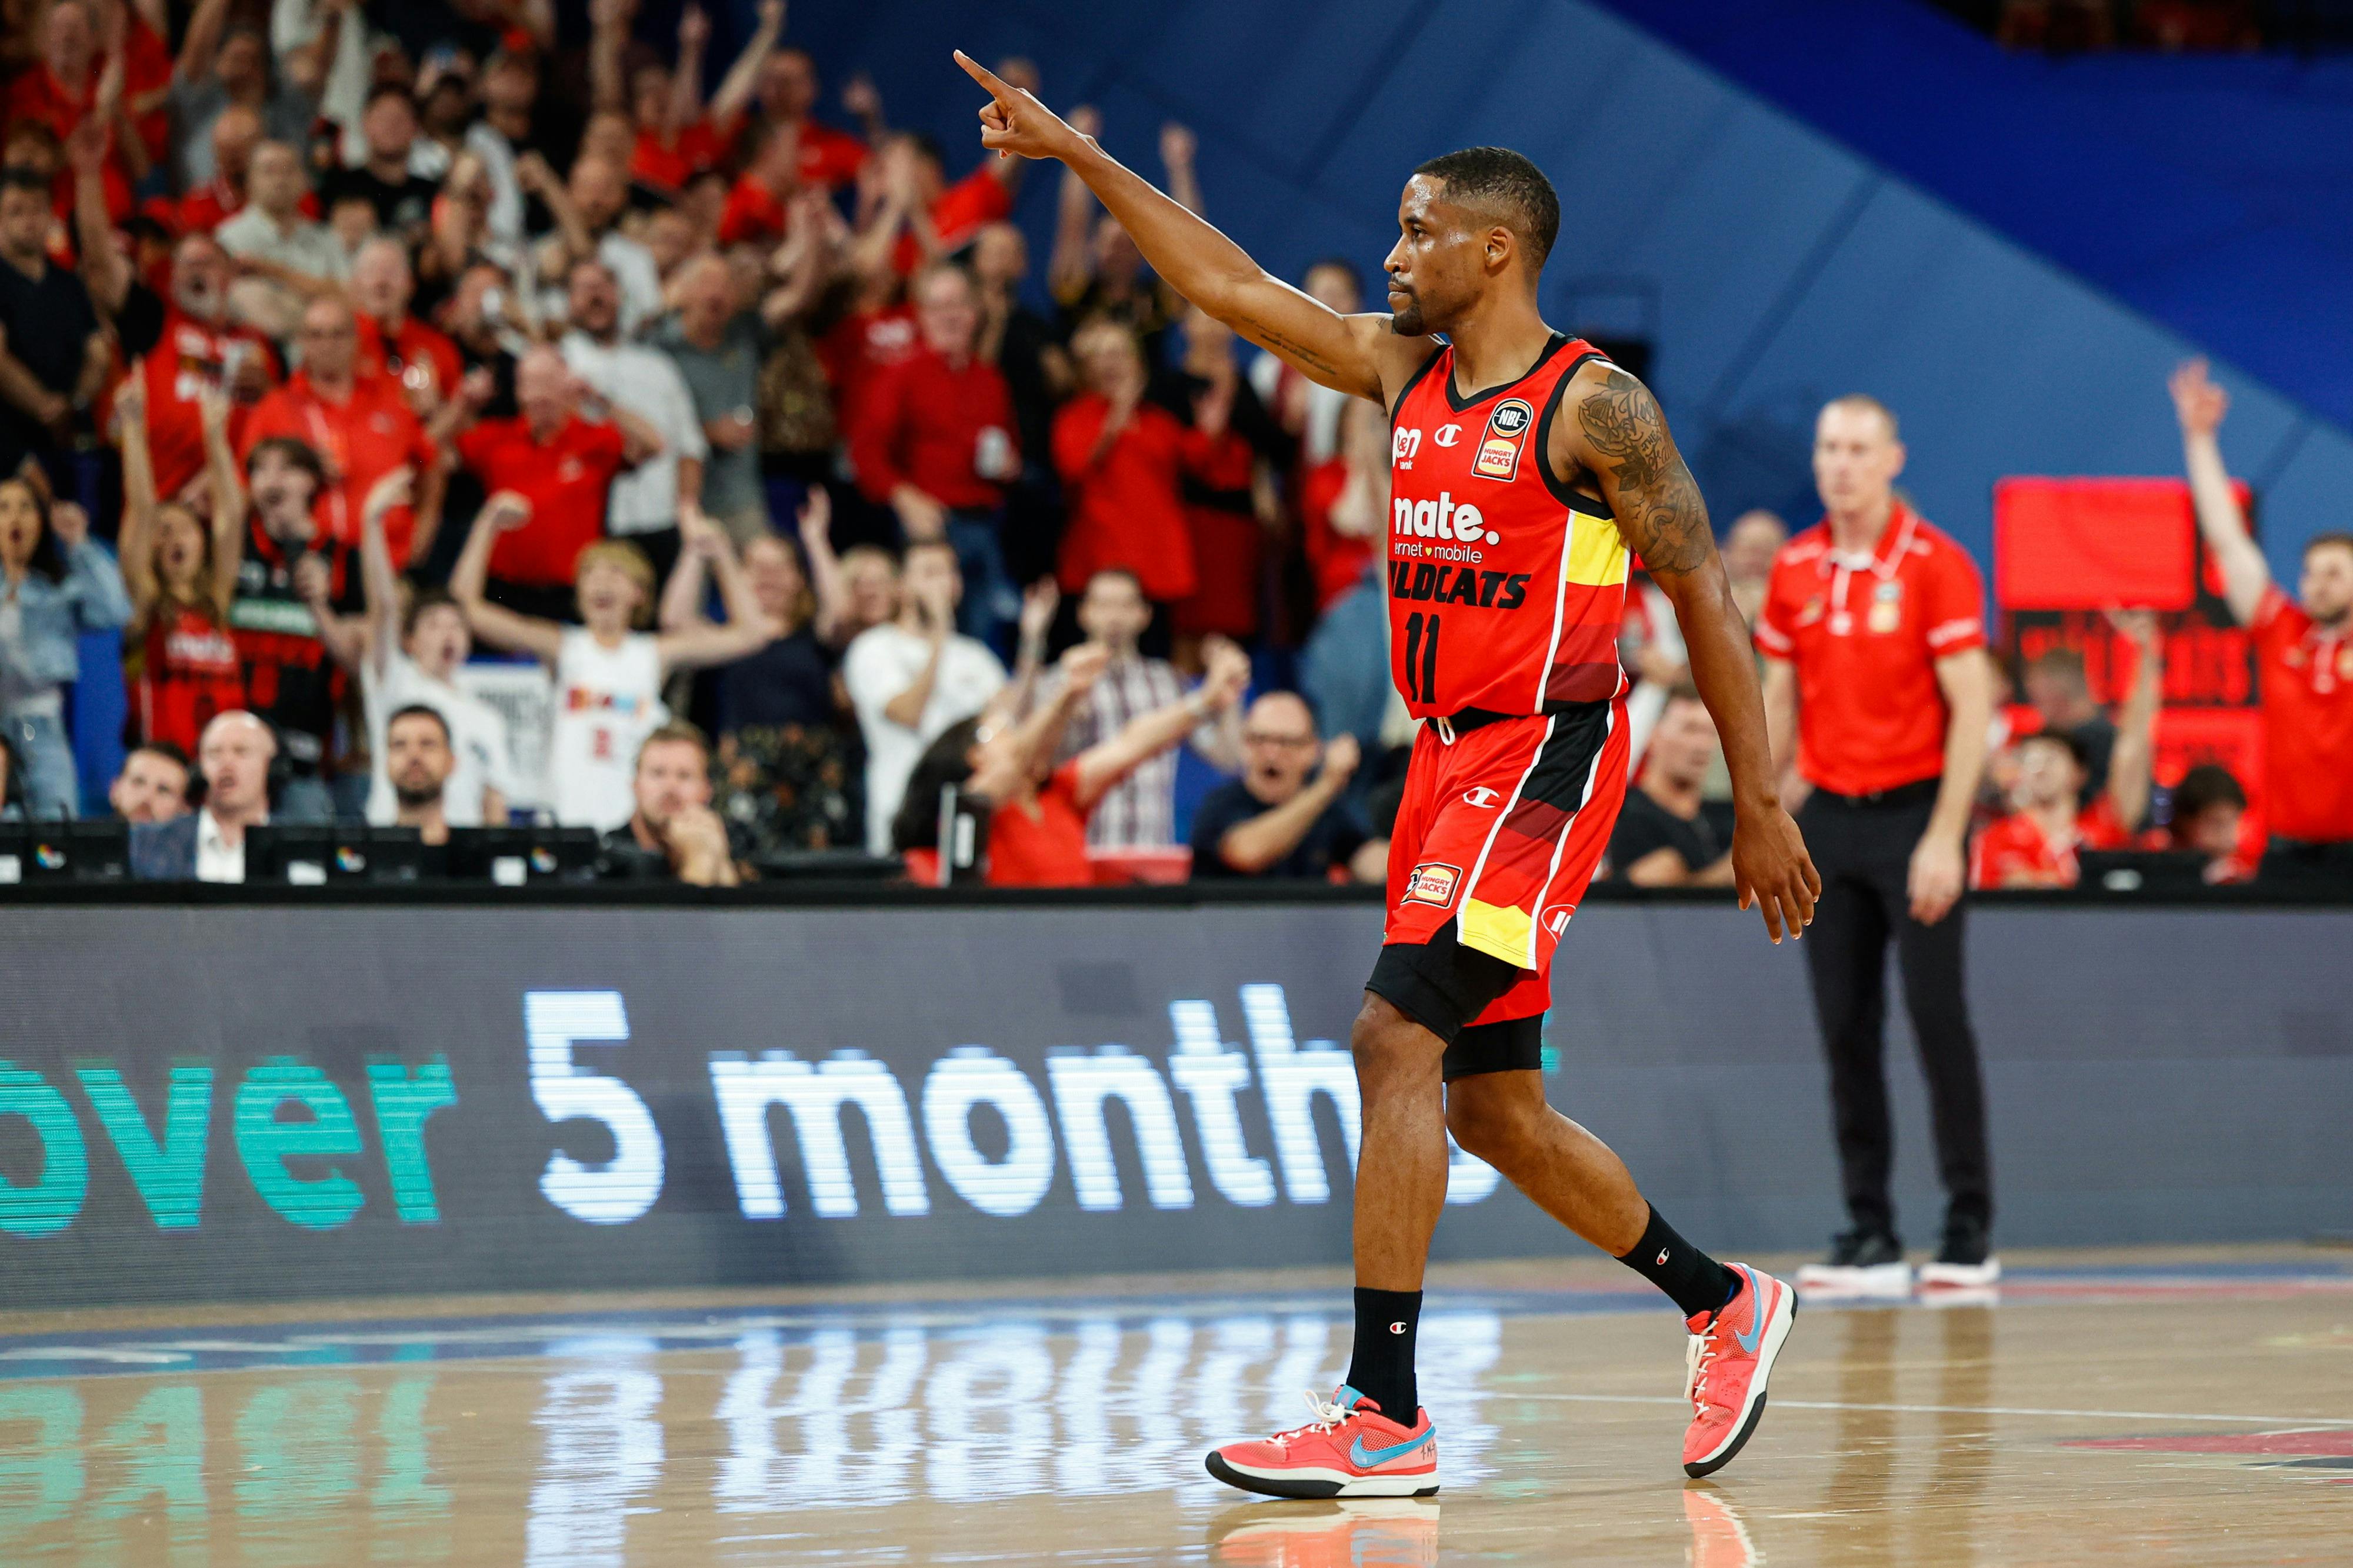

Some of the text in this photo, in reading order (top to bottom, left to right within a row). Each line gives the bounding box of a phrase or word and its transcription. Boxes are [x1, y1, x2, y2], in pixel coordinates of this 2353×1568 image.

[1498, 409, 1522, 428] NBL
[1484, 448, 1512, 458] HUNGRY
[1434, 543, 1483, 563] mobile
[1405, 612, 1441, 704] 11
[1421, 875, 1450, 886] HUNGRY
[0, 1056, 458, 1239] over
[522, 989, 666, 1225] 5
